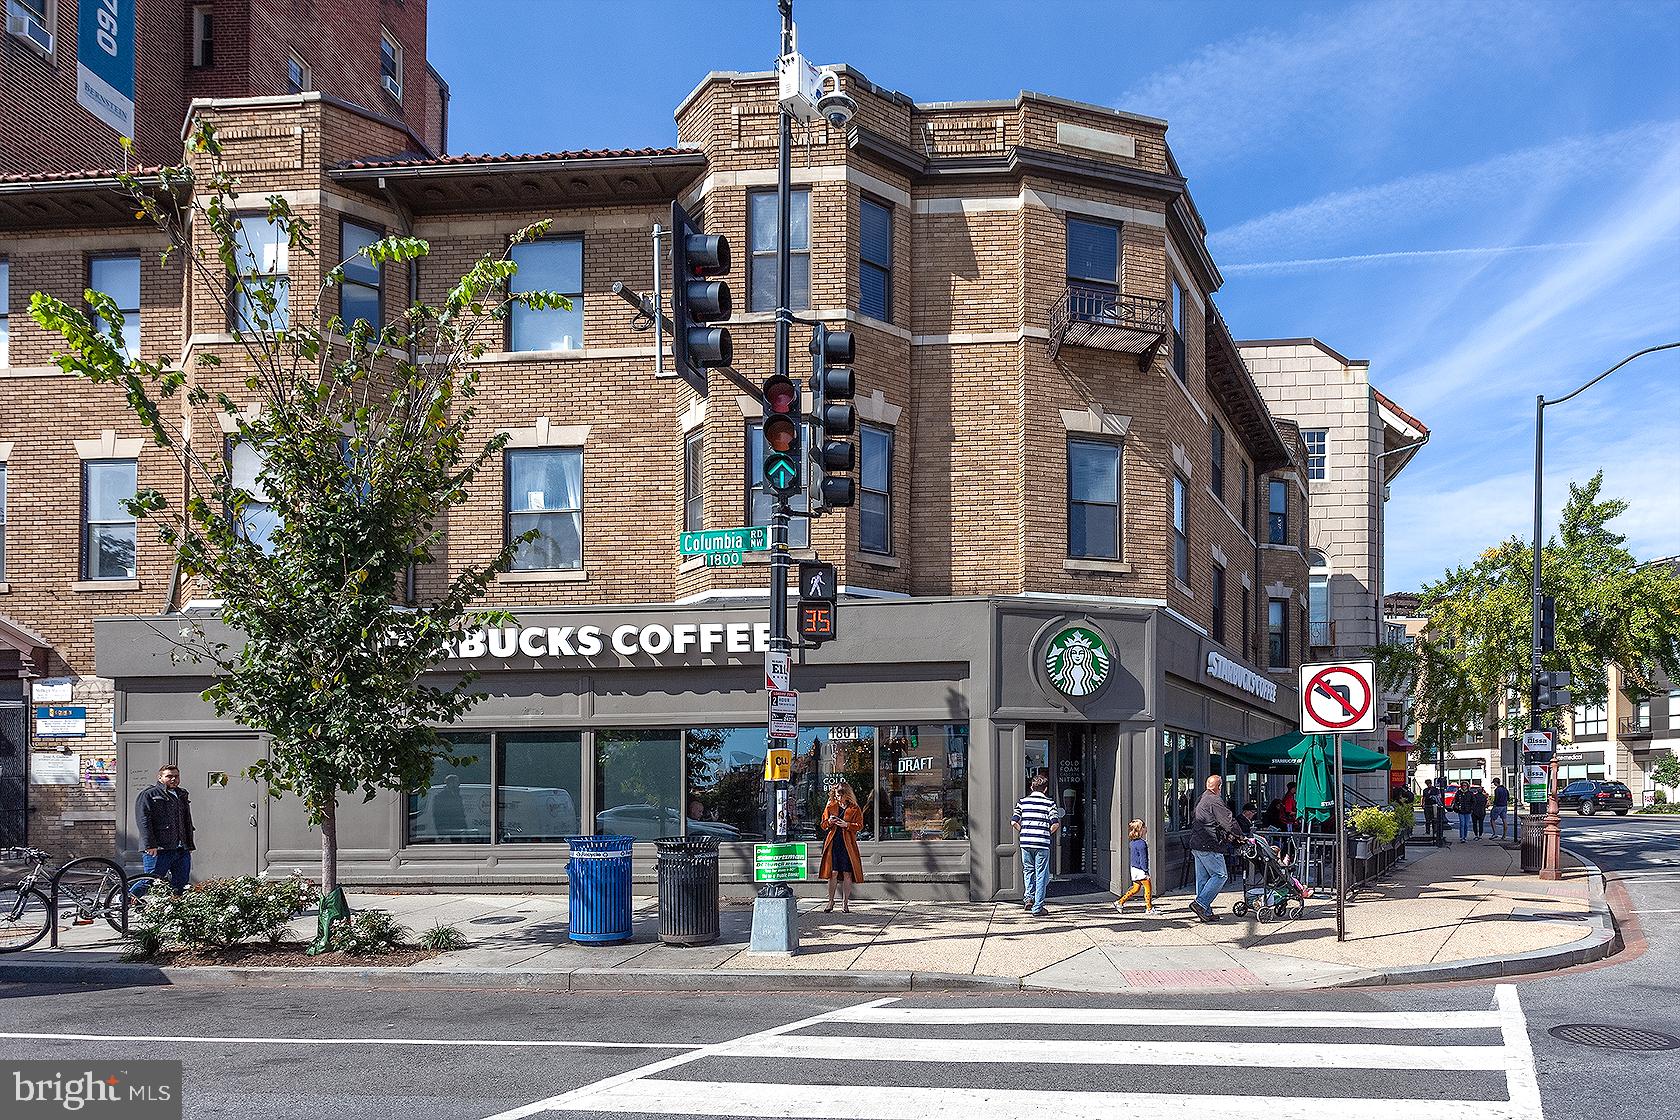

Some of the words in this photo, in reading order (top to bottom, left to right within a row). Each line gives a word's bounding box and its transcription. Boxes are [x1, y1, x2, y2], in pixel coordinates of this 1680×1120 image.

[84, 81, 127, 120] BERNSTEIN
[751, 530, 763, 538] RD
[684, 532, 743, 551] Columbia
[751, 539, 764, 547] NW
[709, 553, 740, 565] 1800
[805, 609, 830, 632] 35
[772, 697, 777, 706] 2
[830, 727, 857, 739] 1801
[898, 757, 934, 773] DRAFT
[823, 777, 846, 785] COLD
